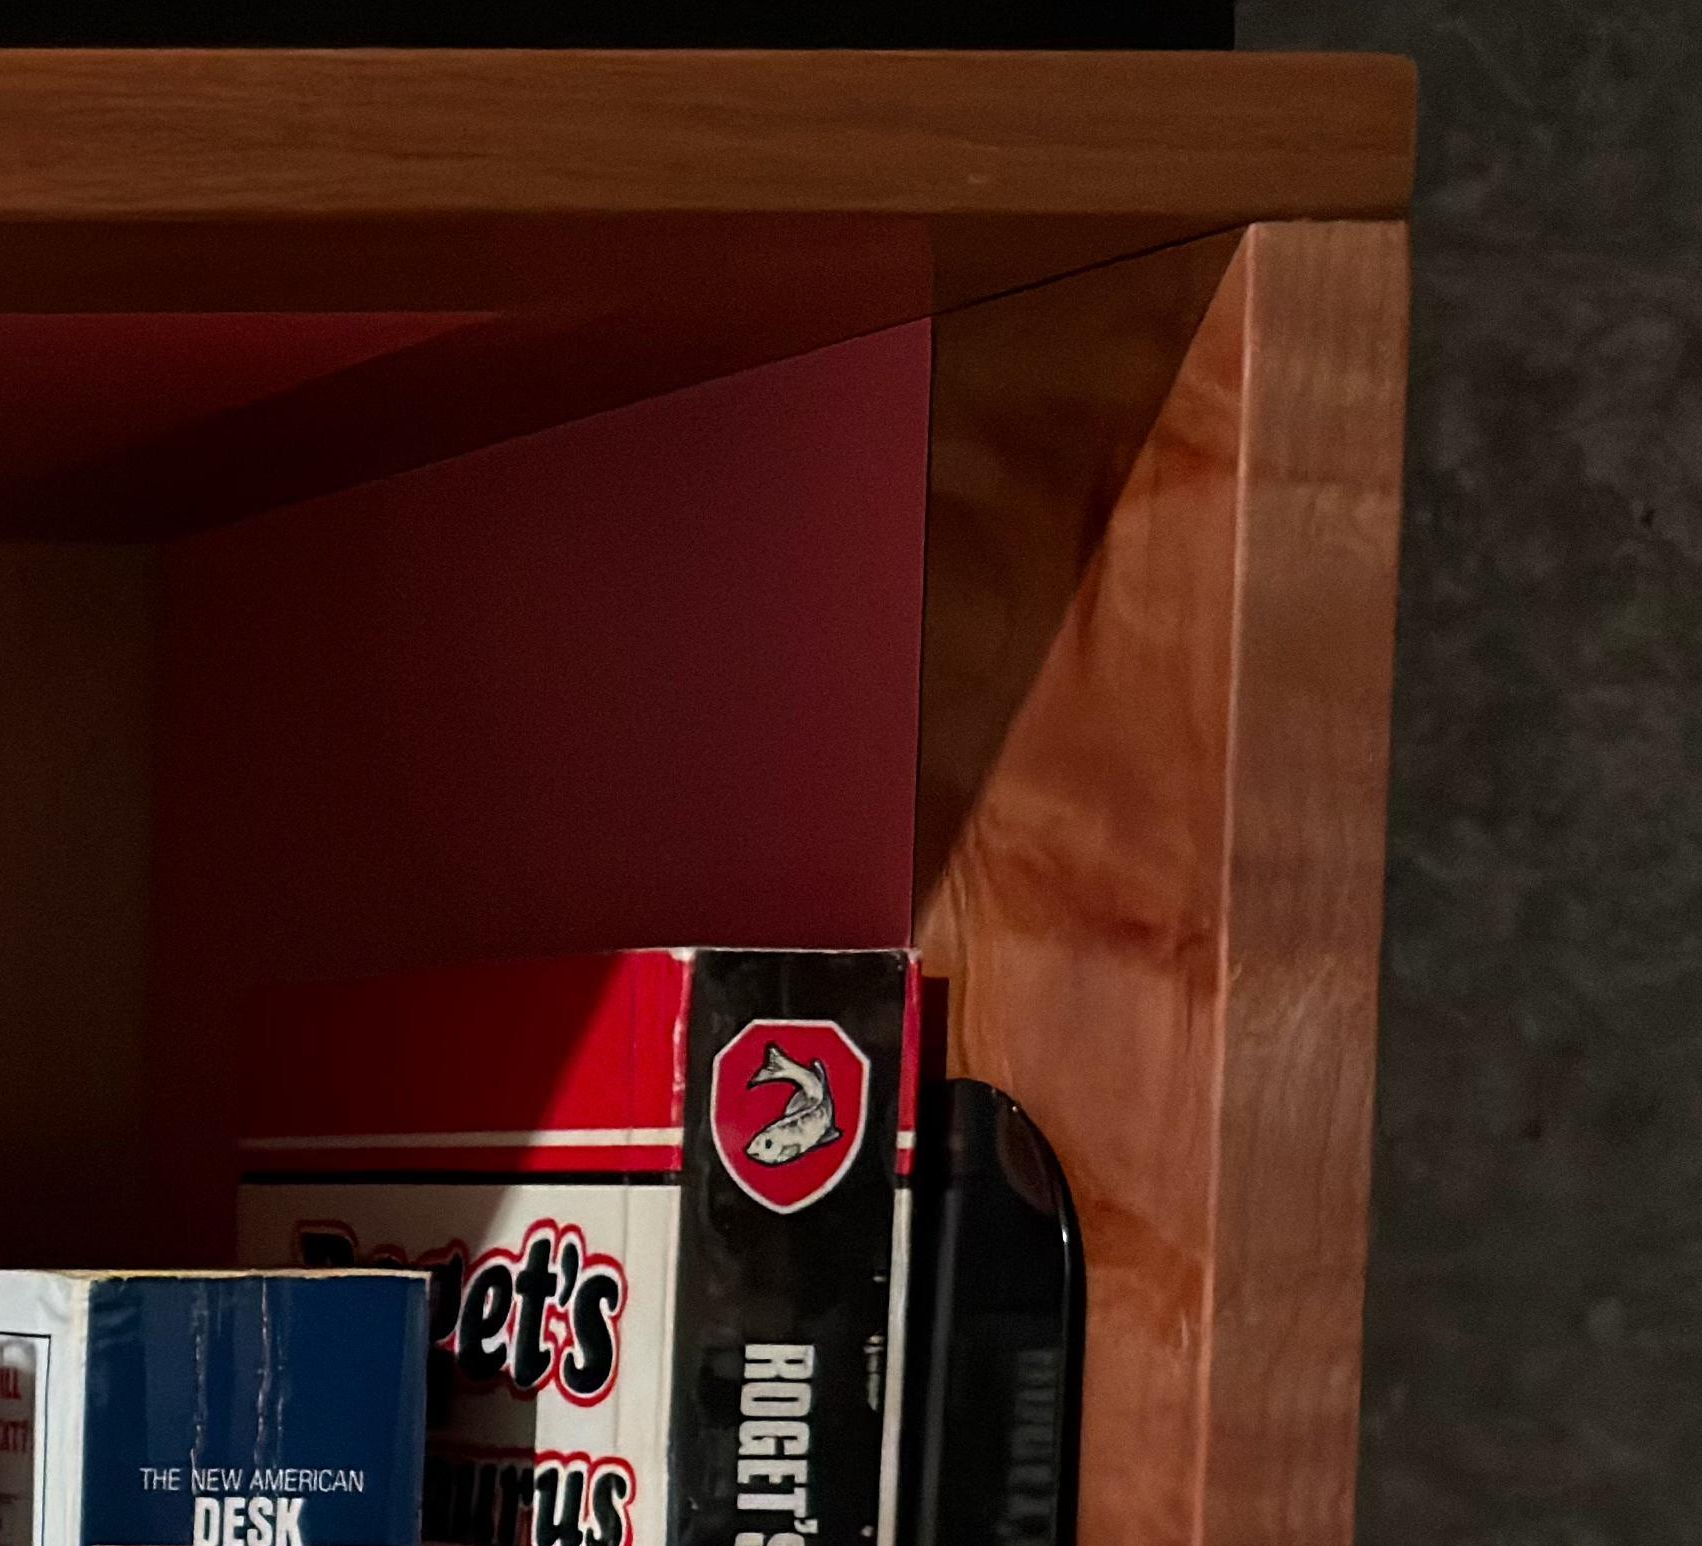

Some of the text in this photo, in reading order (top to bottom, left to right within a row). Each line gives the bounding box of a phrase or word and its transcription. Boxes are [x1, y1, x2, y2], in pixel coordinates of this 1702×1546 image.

[140, 1468, 365, 1493] THE NEW AMERICAN
